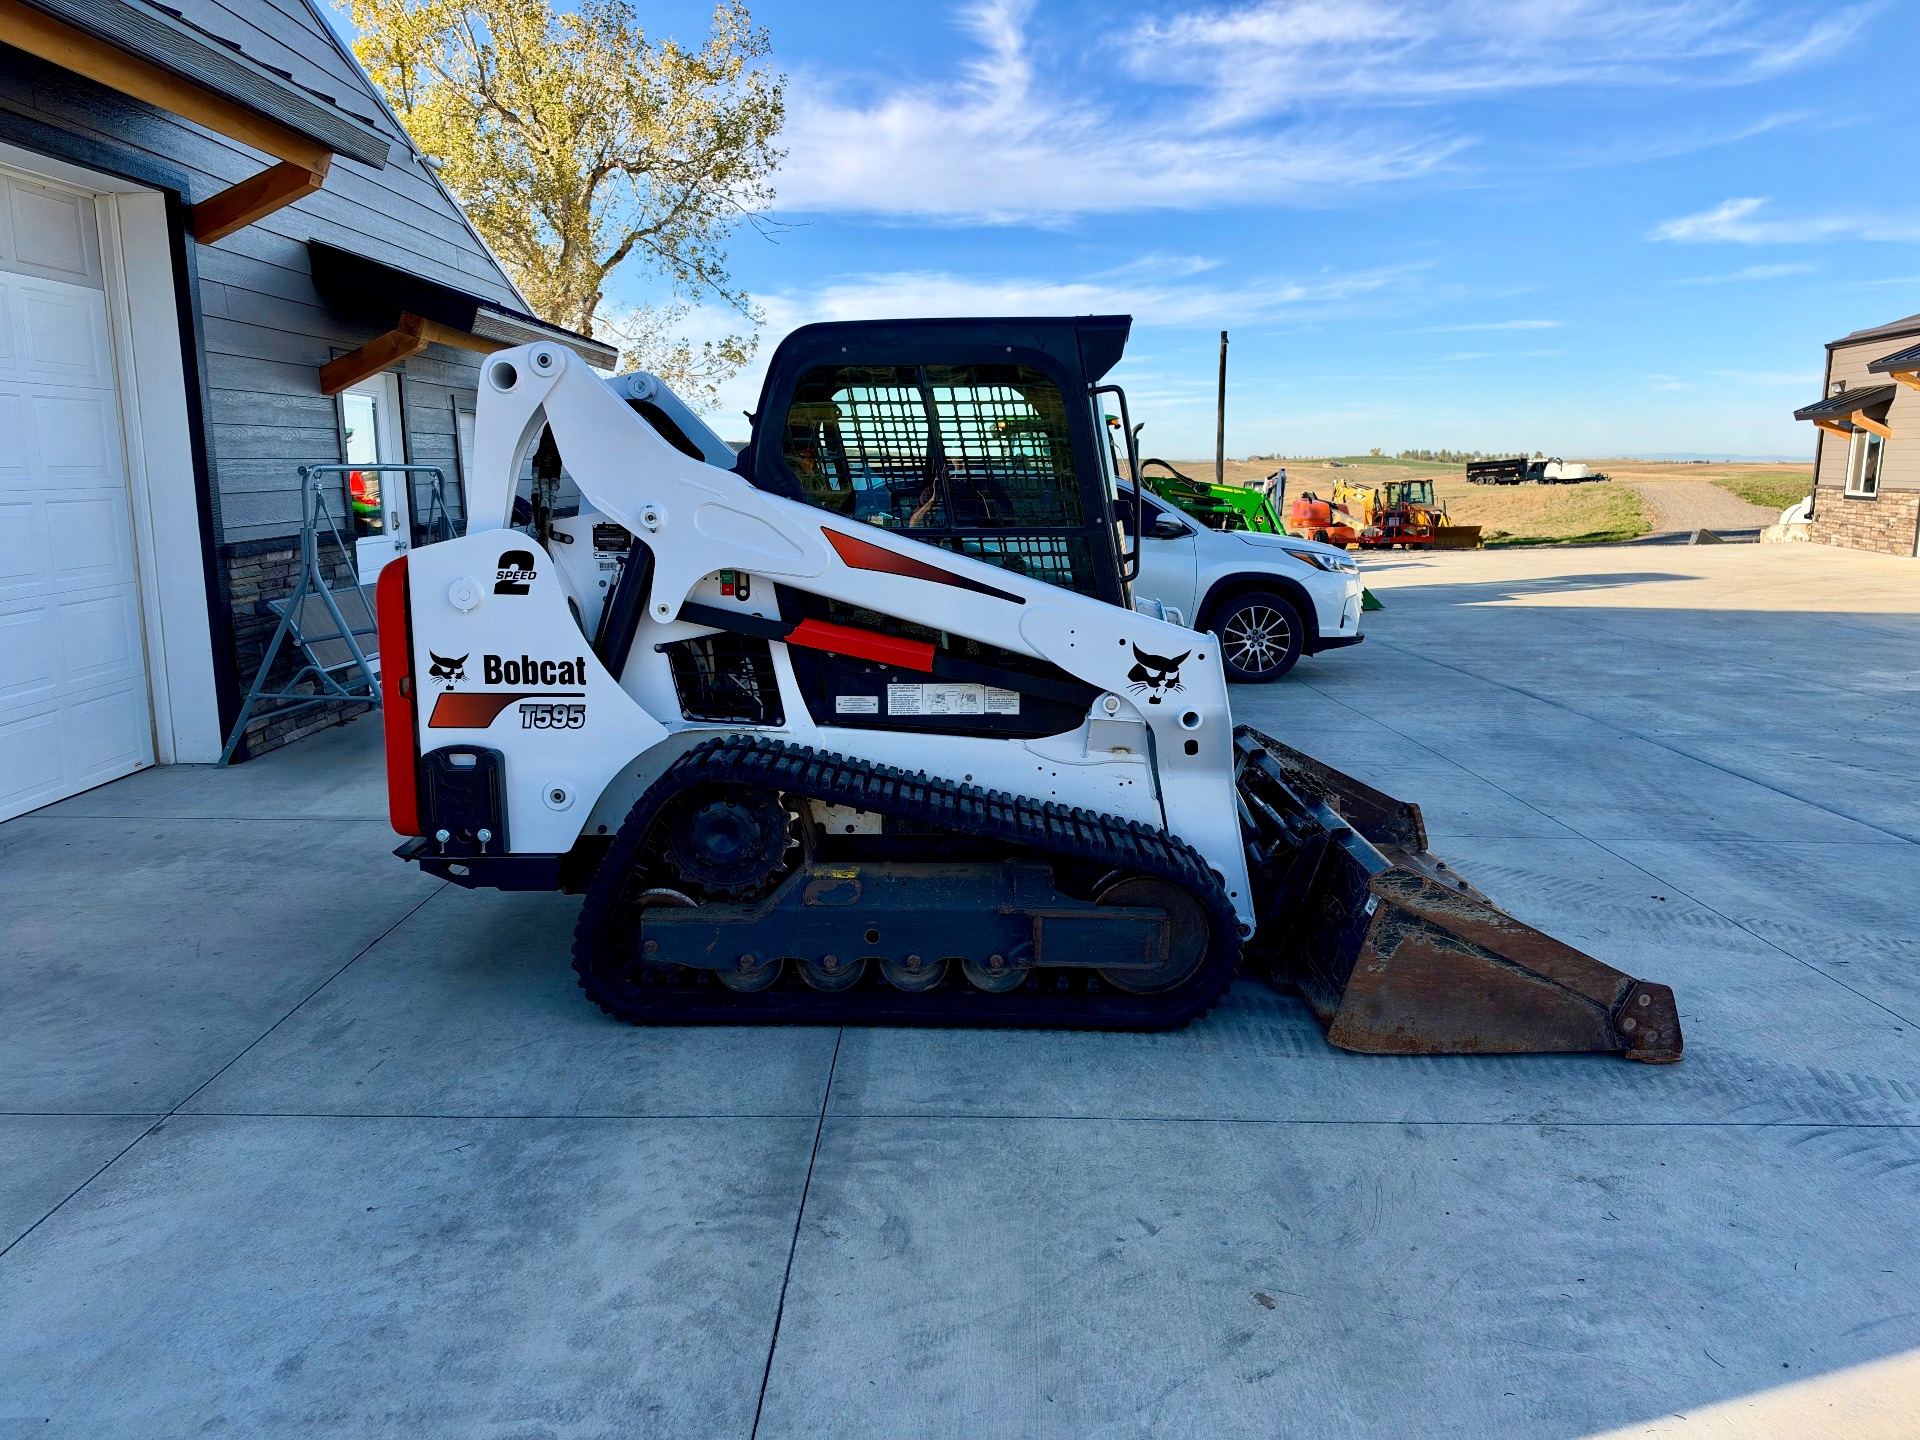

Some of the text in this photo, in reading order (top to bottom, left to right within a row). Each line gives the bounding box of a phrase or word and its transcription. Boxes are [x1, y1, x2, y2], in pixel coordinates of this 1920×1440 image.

[494, 550, 535, 595] 2
[496, 571, 537, 580] SPEED
[483, 655, 586, 685] Bobcat
[519, 704, 586, 729] T595
